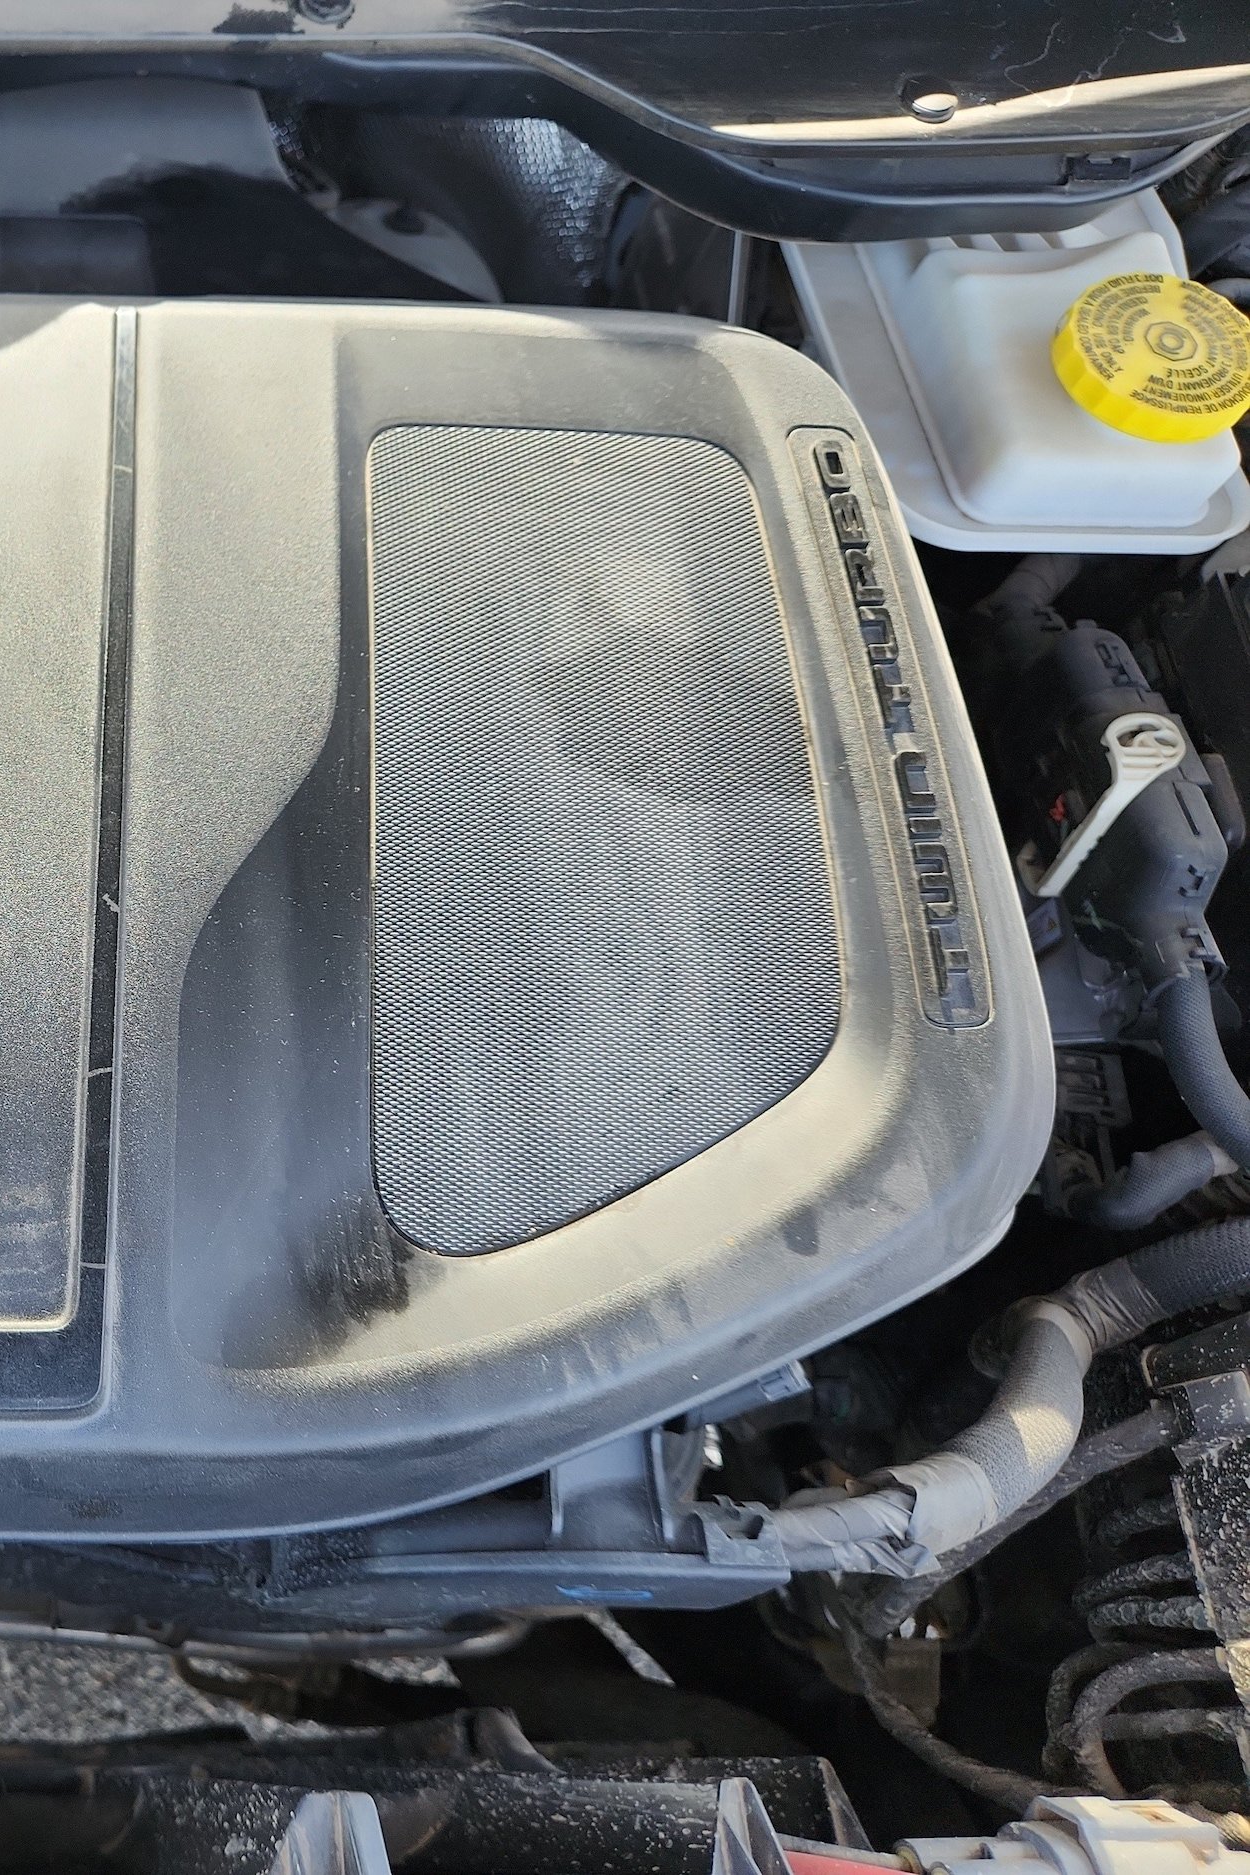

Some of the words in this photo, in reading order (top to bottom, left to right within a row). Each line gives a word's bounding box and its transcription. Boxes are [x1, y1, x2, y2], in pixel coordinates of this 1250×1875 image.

[1177, 366, 1230, 392] PROVENANT
[1210, 372, 1244, 399] UTILISER
[1142, 384, 1212, 403] UNIQUEMENT
[1203, 403, 1219, 414] DE
[813, 440, 914, 734] TURBO
[894, 748, 972, 1000] TWIN
